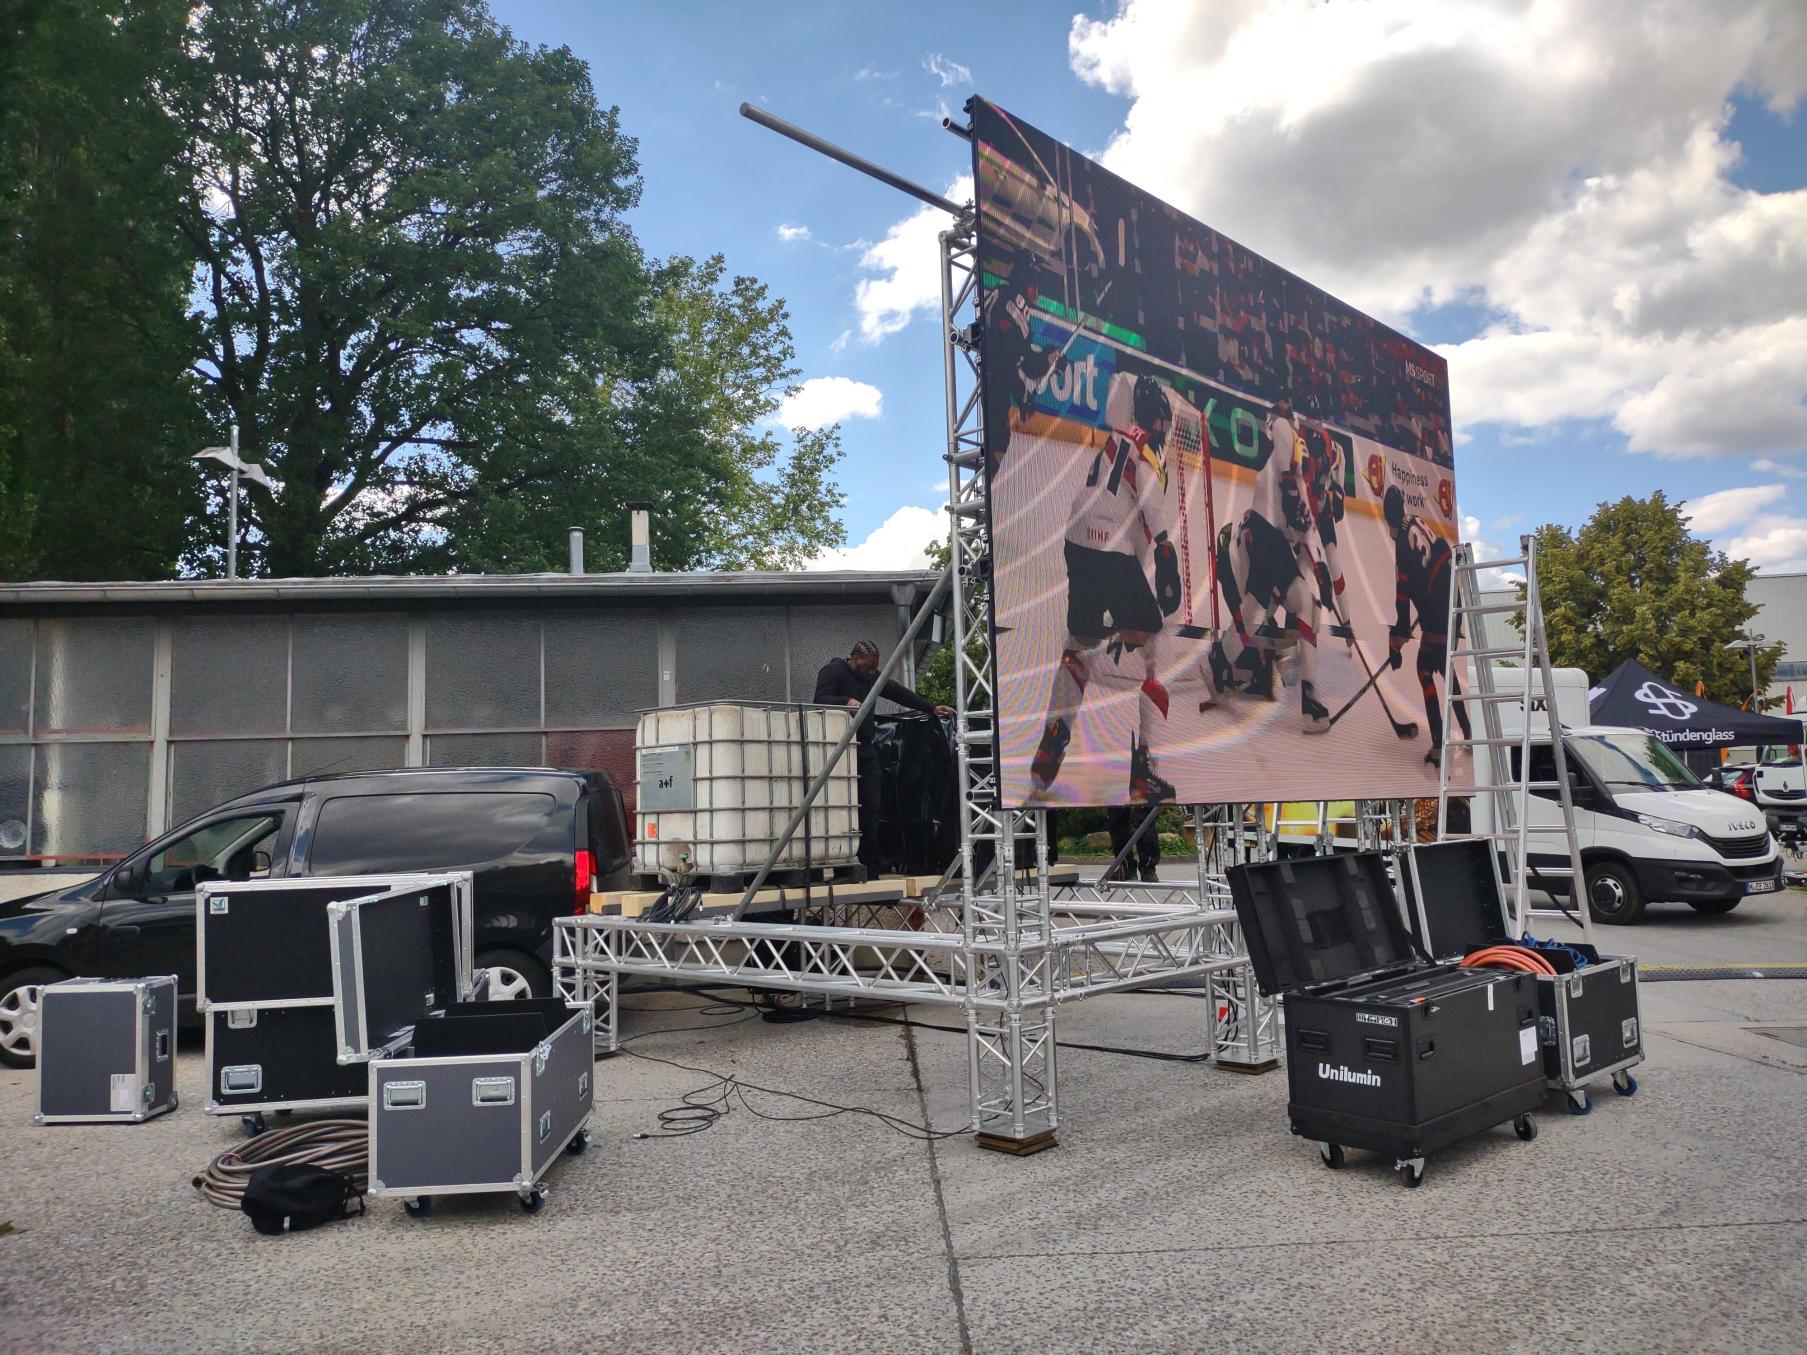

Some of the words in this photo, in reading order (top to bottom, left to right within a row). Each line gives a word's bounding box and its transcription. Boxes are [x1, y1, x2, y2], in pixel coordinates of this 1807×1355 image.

[1391, 461, 1429, 487] Happiness
[1728, 821, 1756, 831] IVECO
[1319, 1062, 1381, 1087] Unilumin
